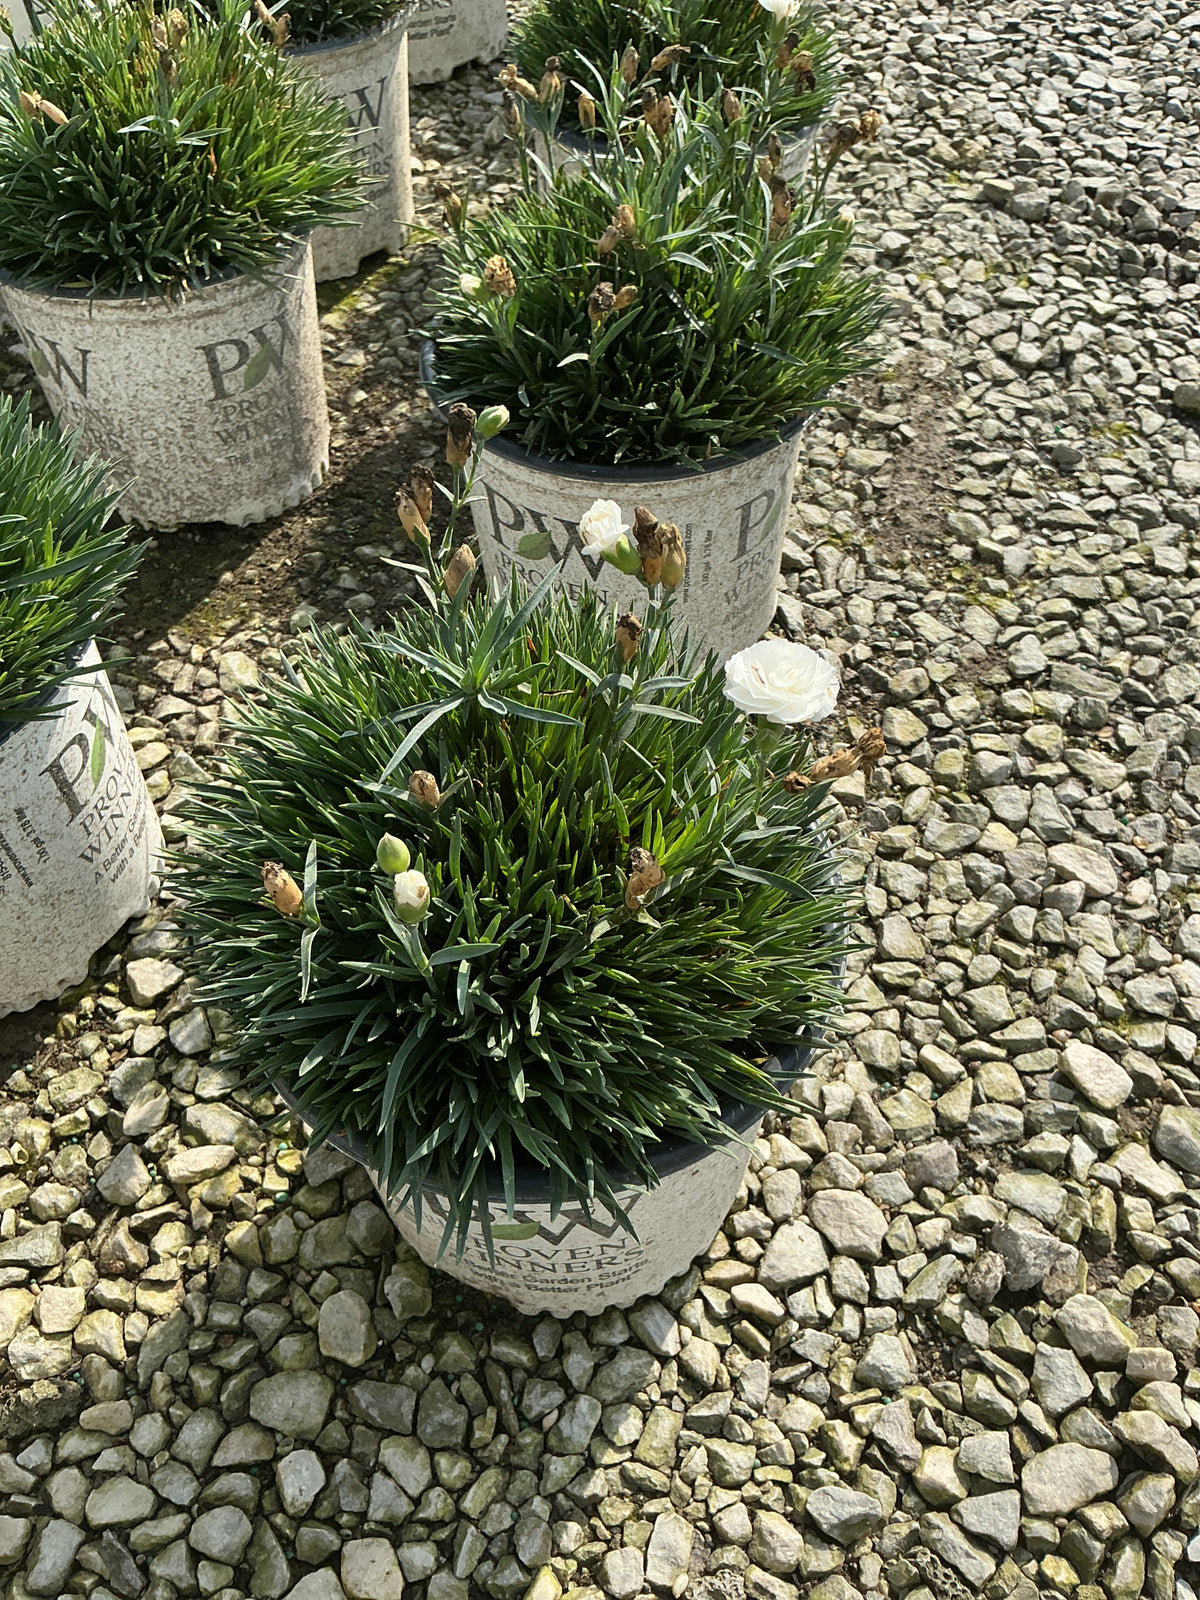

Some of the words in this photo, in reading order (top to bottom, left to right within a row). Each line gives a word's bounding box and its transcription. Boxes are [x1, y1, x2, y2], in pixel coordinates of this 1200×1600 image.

[341, 76, 388, 142] W
[21, 322, 92, 400] W
[480, 478, 609, 582] PW
[94, 871, 104, 885] A
[102, 833, 129, 872] Better
[110, 857, 129, 884] with
[129, 847, 135, 858] a
[464, 1245, 645, 1274] INNERS
[466, 1235, 628, 1261] ROVEN
[522, 1274, 592, 1285] Garden
[598, 1258, 649, 1281] Starts
[524, 1283, 581, 1293] Better
